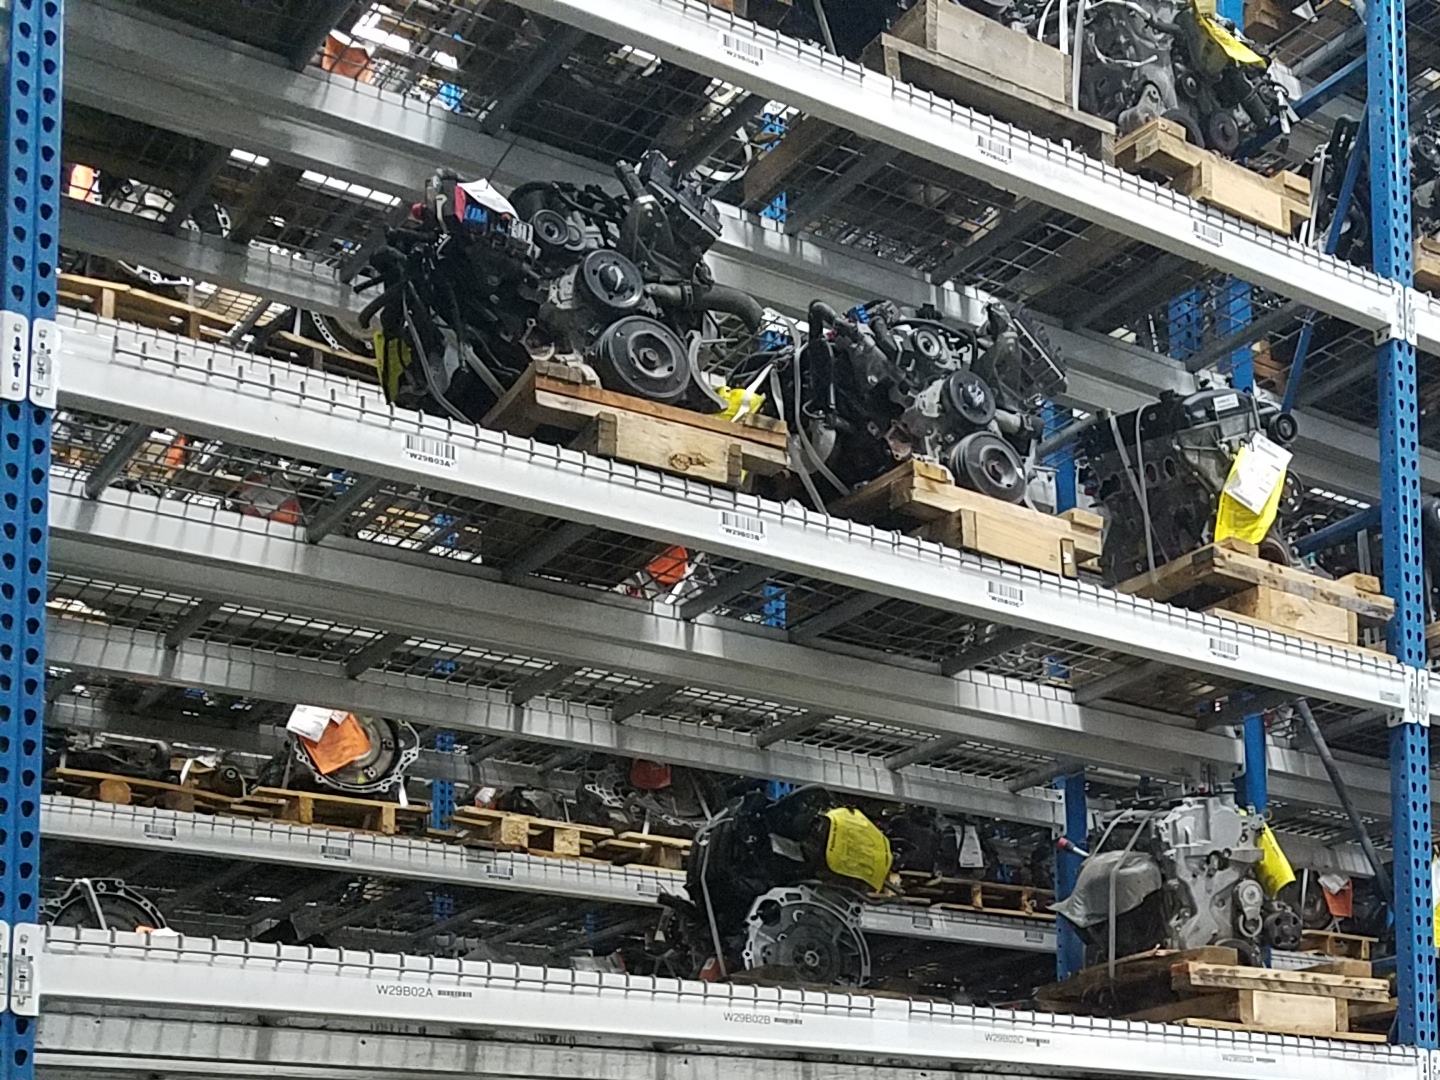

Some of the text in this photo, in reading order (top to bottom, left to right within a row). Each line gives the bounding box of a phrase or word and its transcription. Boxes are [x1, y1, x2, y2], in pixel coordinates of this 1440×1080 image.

[408, 452, 452, 468] W29B03A
[376, 984, 433, 998] W29B02A
[723, 1012, 771, 1025] W29B02B
[984, 1033, 1025, 1045] W29B02C
